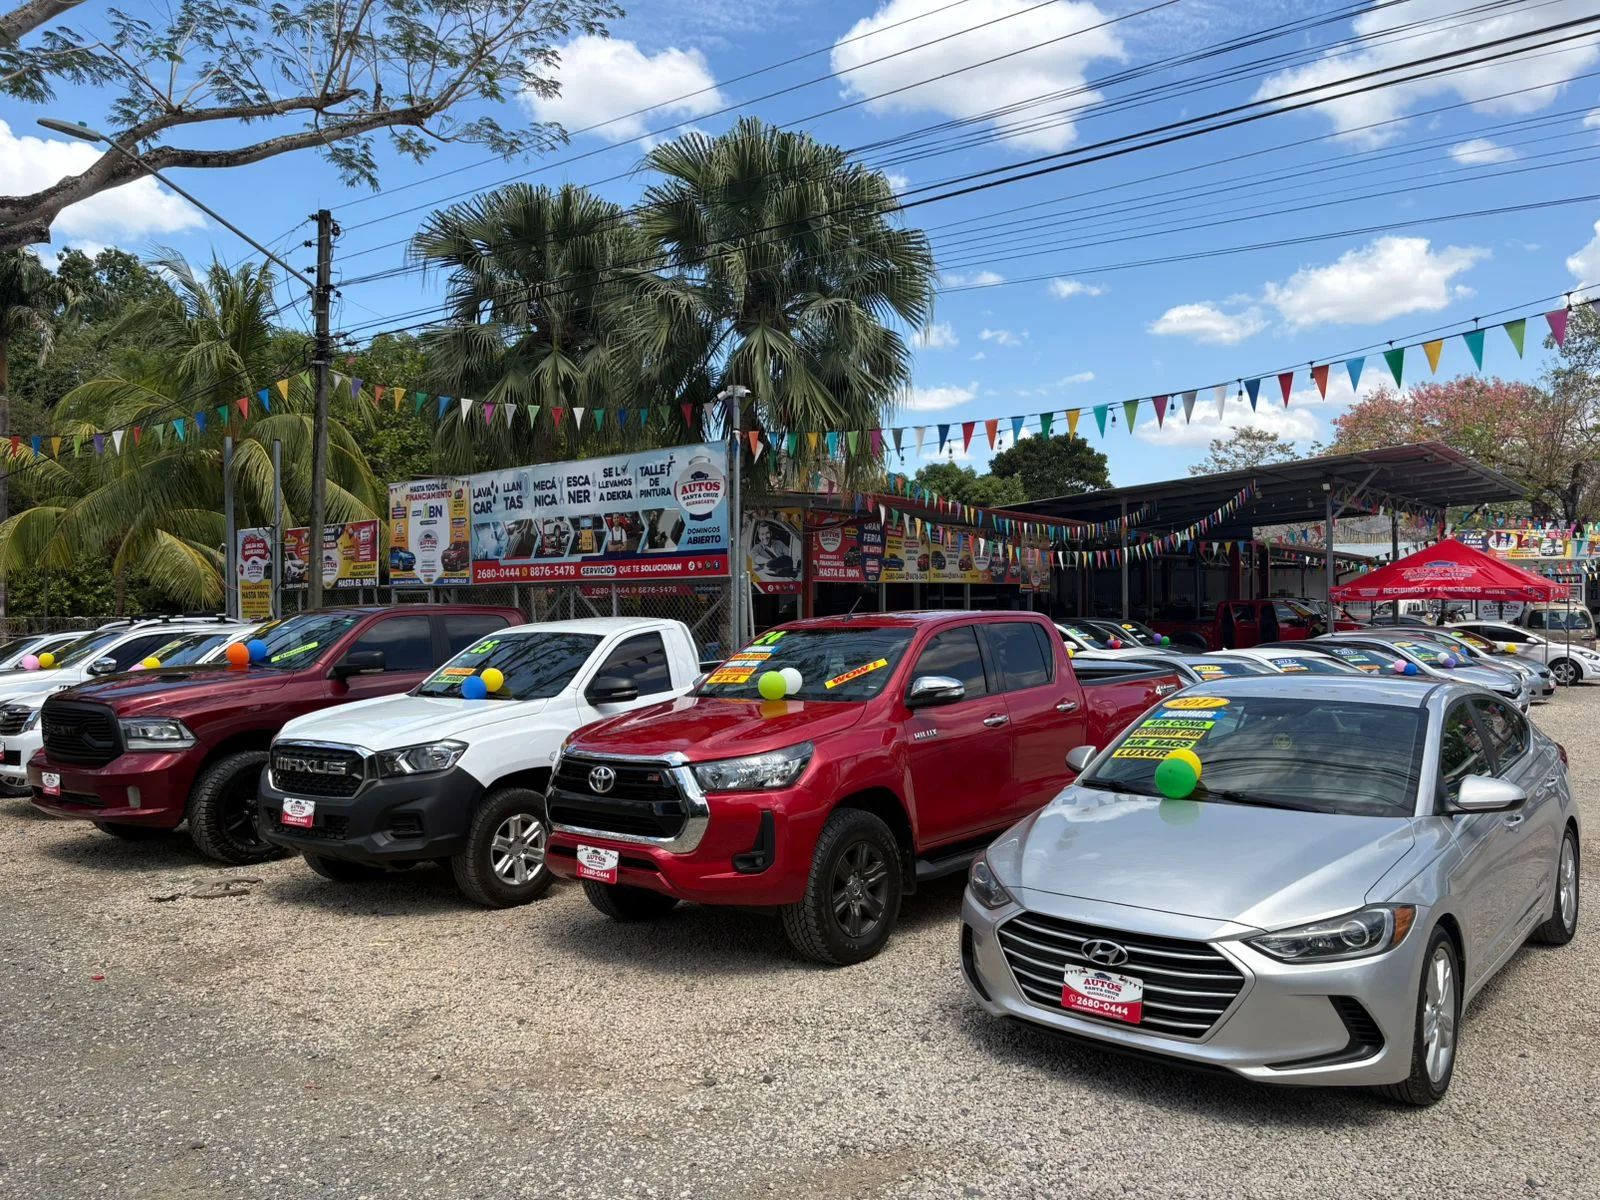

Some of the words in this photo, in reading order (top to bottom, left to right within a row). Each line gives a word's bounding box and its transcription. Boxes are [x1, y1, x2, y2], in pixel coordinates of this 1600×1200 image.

[603, 467, 614, 478] SE
[503, 481, 522, 492] LLAN
[534, 476, 556, 492] MECÁ
[566, 475, 590, 488] ESCA
[598, 478, 632, 489] LLEVAMOS
[649, 478, 660, 487] DE
[473, 486, 492, 498] LAVA
[640, 488, 672, 498] PINTURA
[681, 482, 720, 494] AUTOS
[406, 490, 452, 500] FINANCIAMIENTO
[534, 494, 558, 508] NICA
[568, 490, 590, 504] NER
[599, 493, 605, 502] A
[606, 490, 632, 501] DEKRA
[473, 501, 492, 514] CAR
[504, 496, 524, 511] TAS
[428, 505, 442, 518] BN
[687, 526, 720, 535] DOMINGOS
[687, 535, 722, 544] ABIERTO
[864, 533, 881, 542] FERIA
[477, 568, 520, 578] 2680-0444
[530, 566, 575, 576] 8876-5478
[582, 566, 616, 575] SERVICIOS
[620, 565, 632, 574] QUE
[633, 564, 640, 572] TE
[640, 563, 682, 572] SOLUCIONAN
[819, 568, 838, 577] HASTA
[839, 568, 845, 577] EL
[355, 578, 362, 586] EL
[832, 666, 869, 684] WOW
[1171, 720, 1206, 728] COND.
[276, 757, 346, 775] MAXUS
[1084, 978, 1122, 992] AUTOS
[1087, 991, 1115, 1000] GUANACASTE
[1104, 989, 1120, 997] CRUZ
[1077, 997, 1128, 1015] 2680-0444
